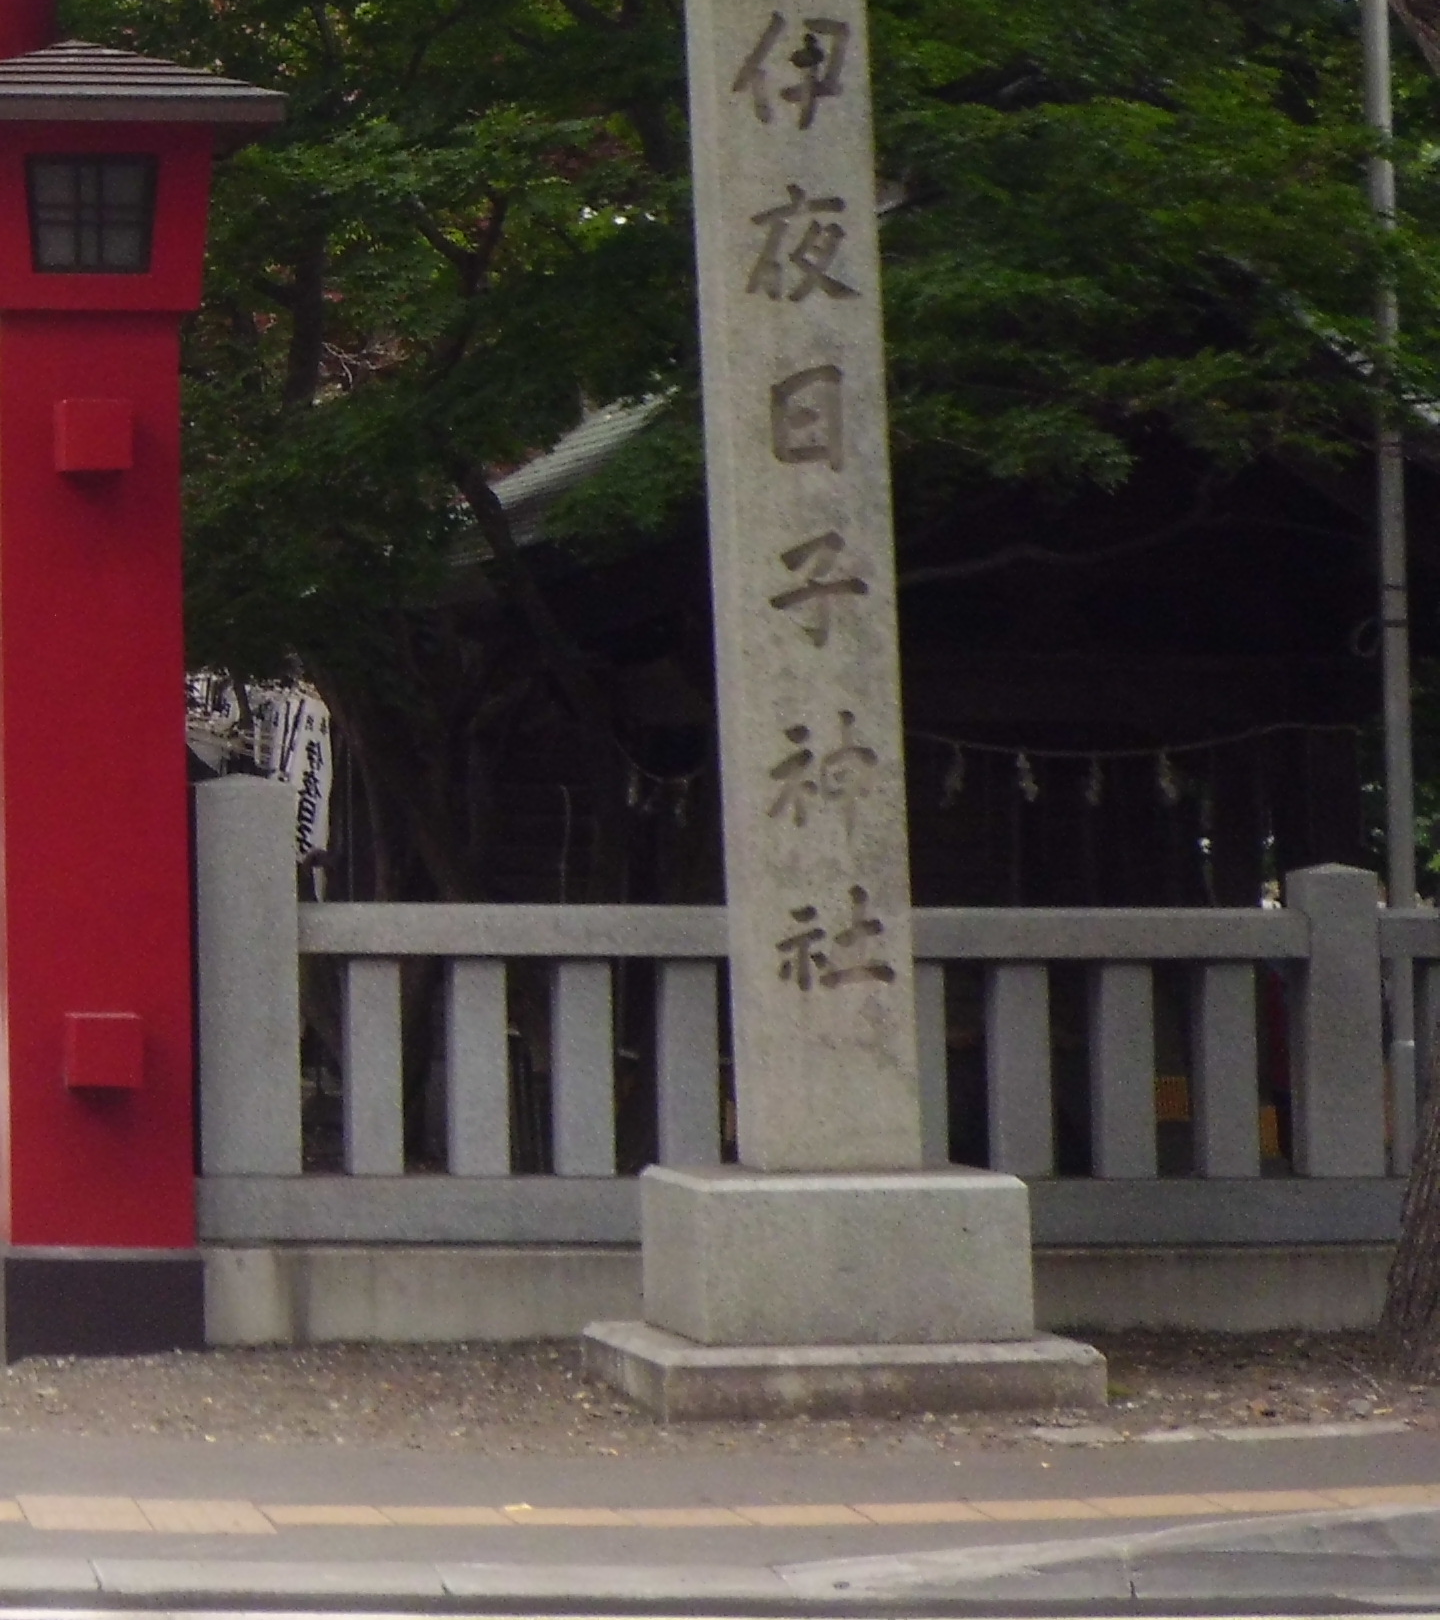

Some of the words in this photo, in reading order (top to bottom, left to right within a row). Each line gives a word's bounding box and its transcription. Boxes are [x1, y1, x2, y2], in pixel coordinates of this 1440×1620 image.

[730, 8, 895, 993] 伊夜日子神社
